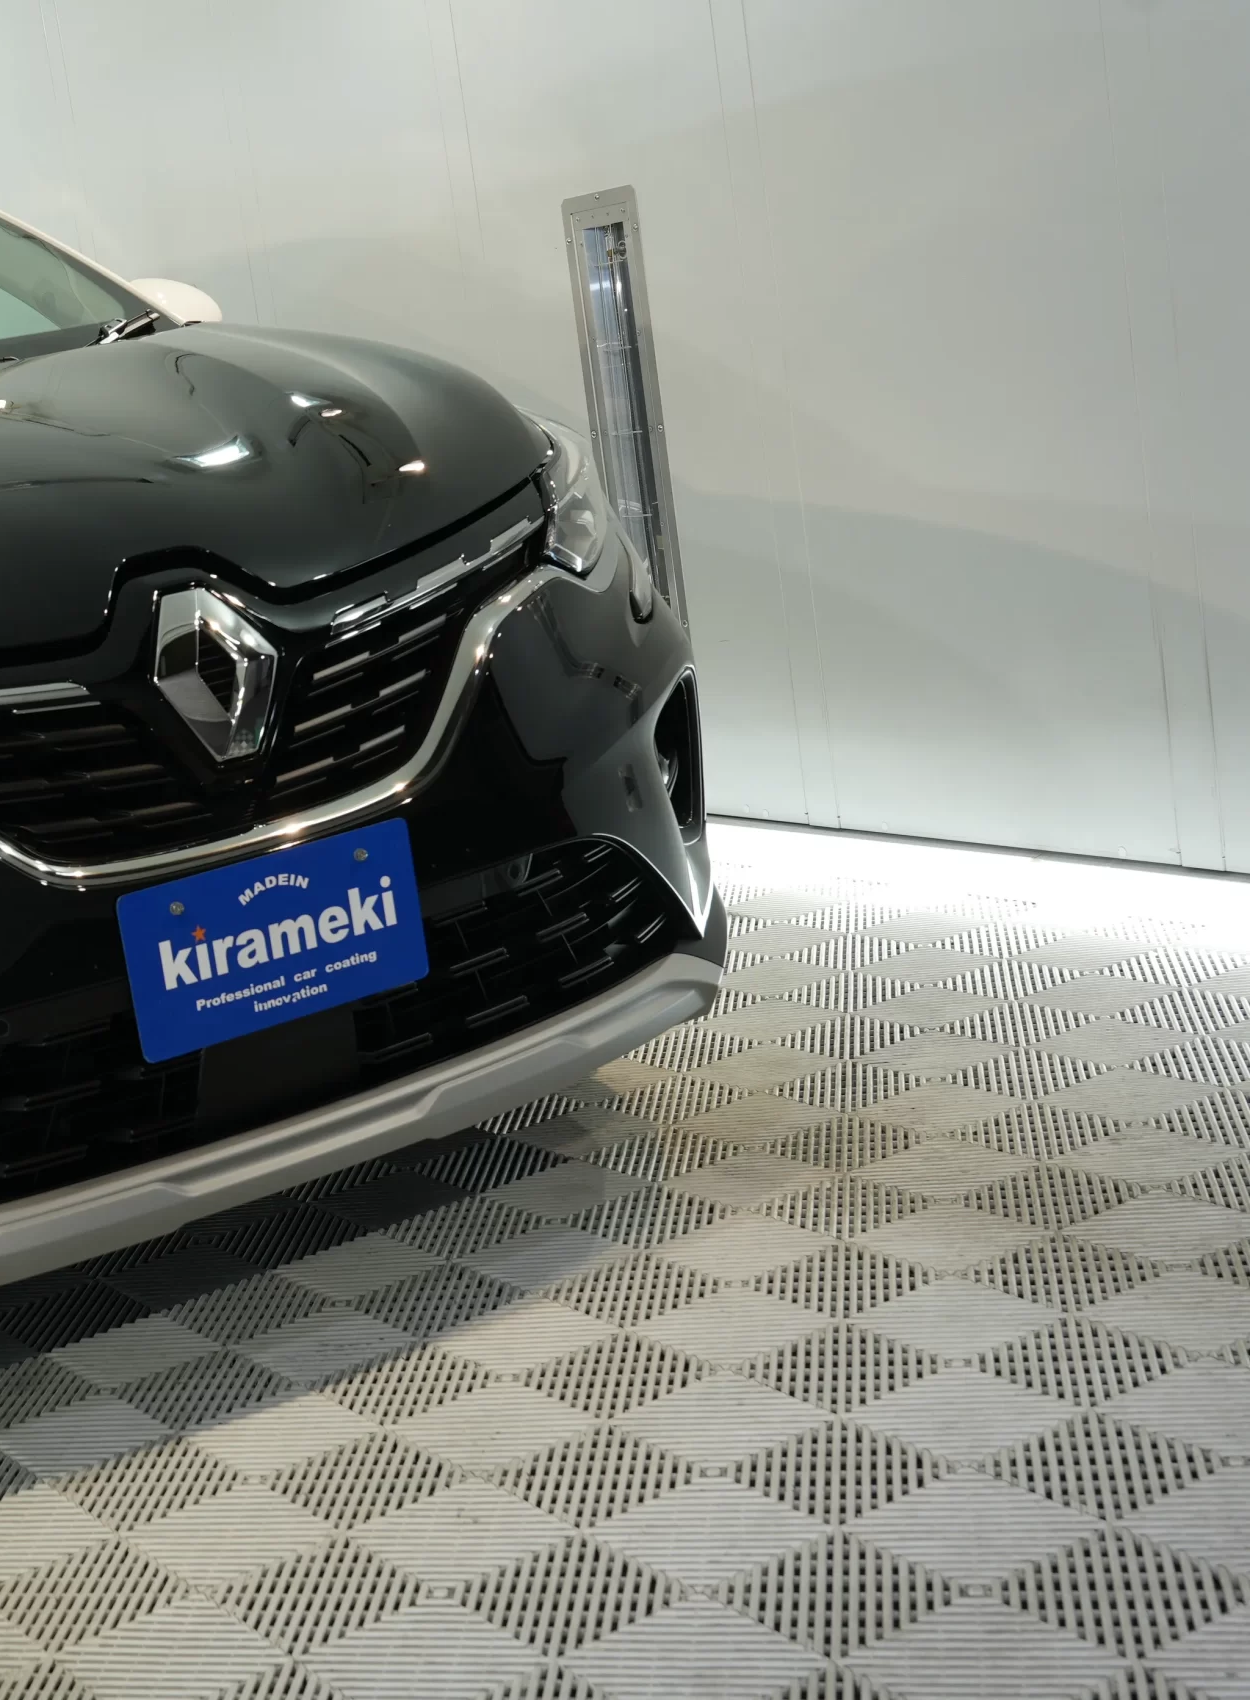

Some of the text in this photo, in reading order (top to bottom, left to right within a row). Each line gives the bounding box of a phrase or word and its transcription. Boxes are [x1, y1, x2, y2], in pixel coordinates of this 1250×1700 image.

[238, 873, 310, 906] MADEIN
[158, 875, 398, 991] kirameki
[196, 950, 378, 1012] Professional car coating
[254, 983, 328, 1013] innovation
